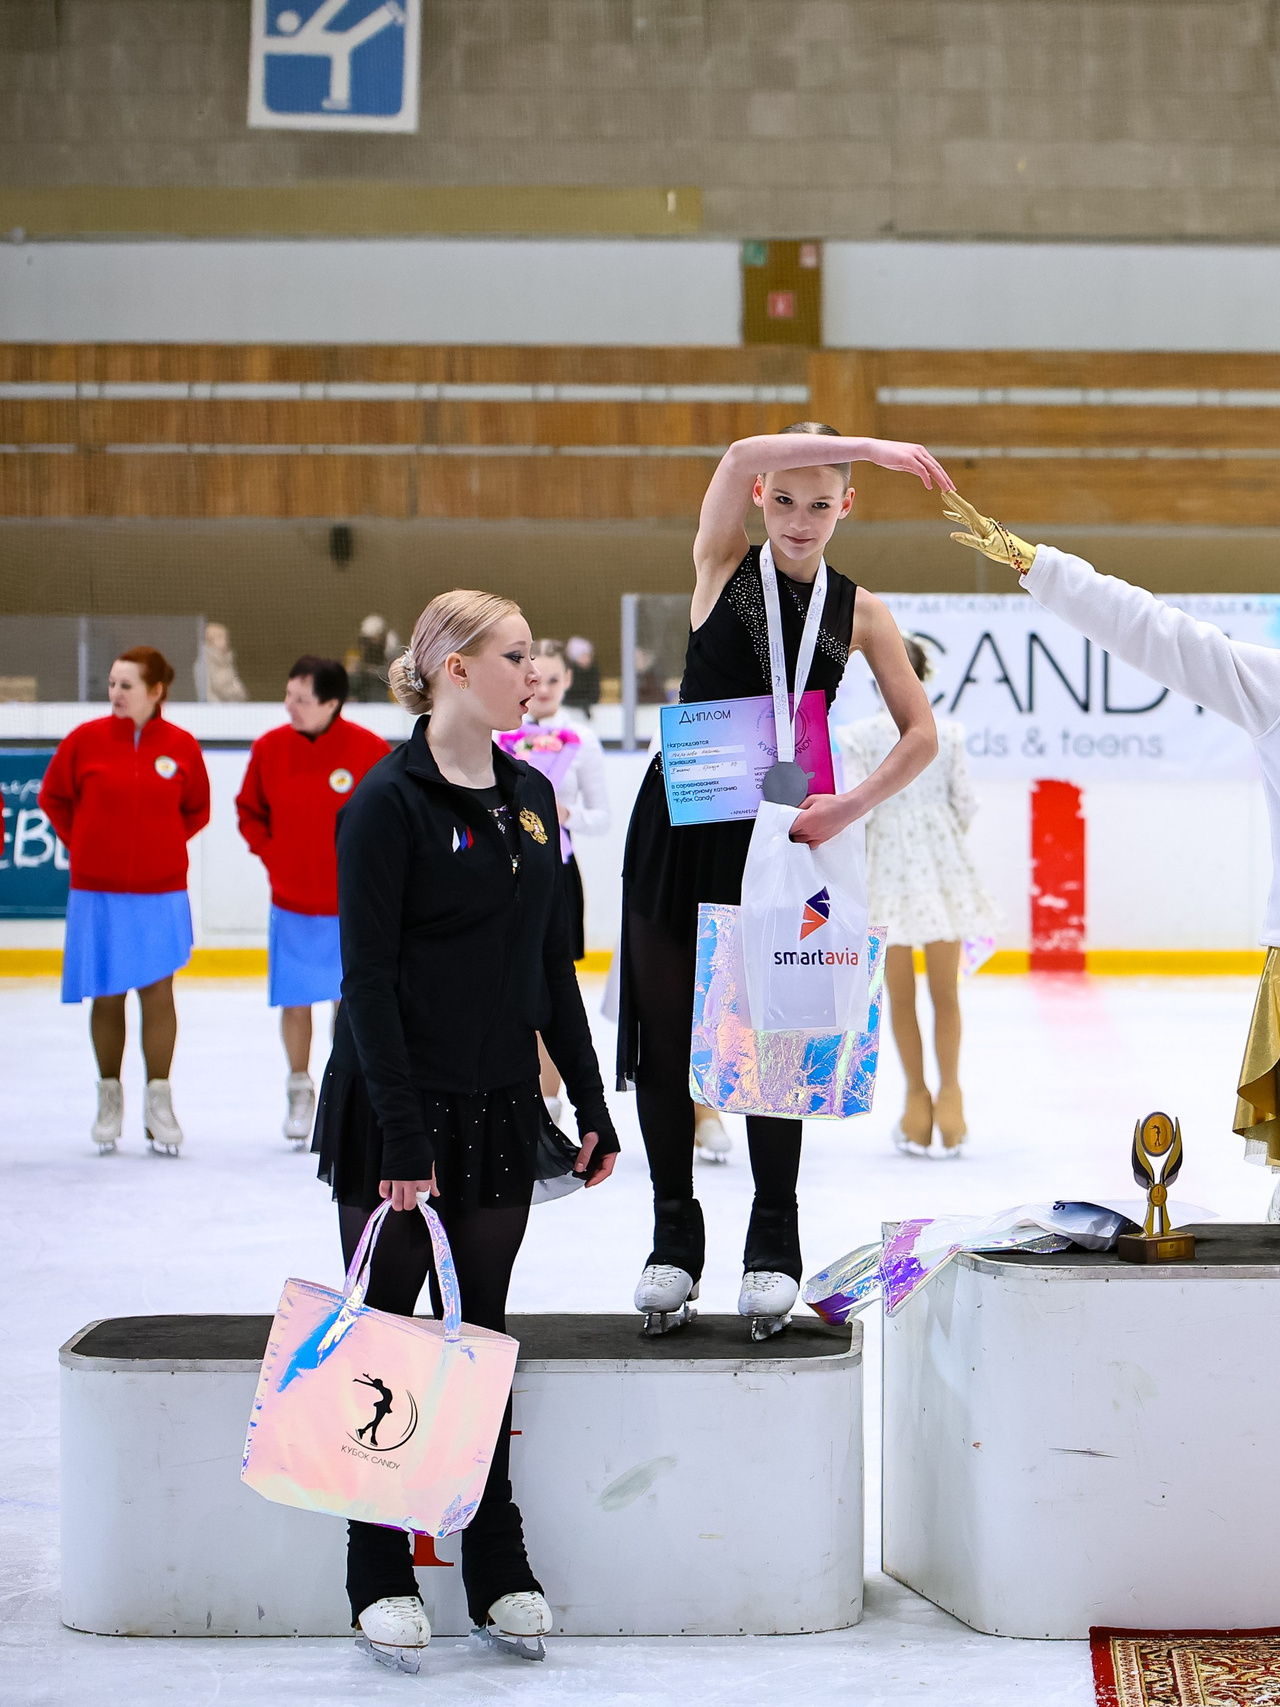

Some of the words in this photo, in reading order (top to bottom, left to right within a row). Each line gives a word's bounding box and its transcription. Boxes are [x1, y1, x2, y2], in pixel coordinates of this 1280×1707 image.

[1021, 727, 1047, 758] &
[1060, 731, 1164, 758] teens
[774, 948, 858, 966] smartavia
[340, 1444, 370, 1461] КУБОК
[370, 1456, 400, 1470] CANDY
